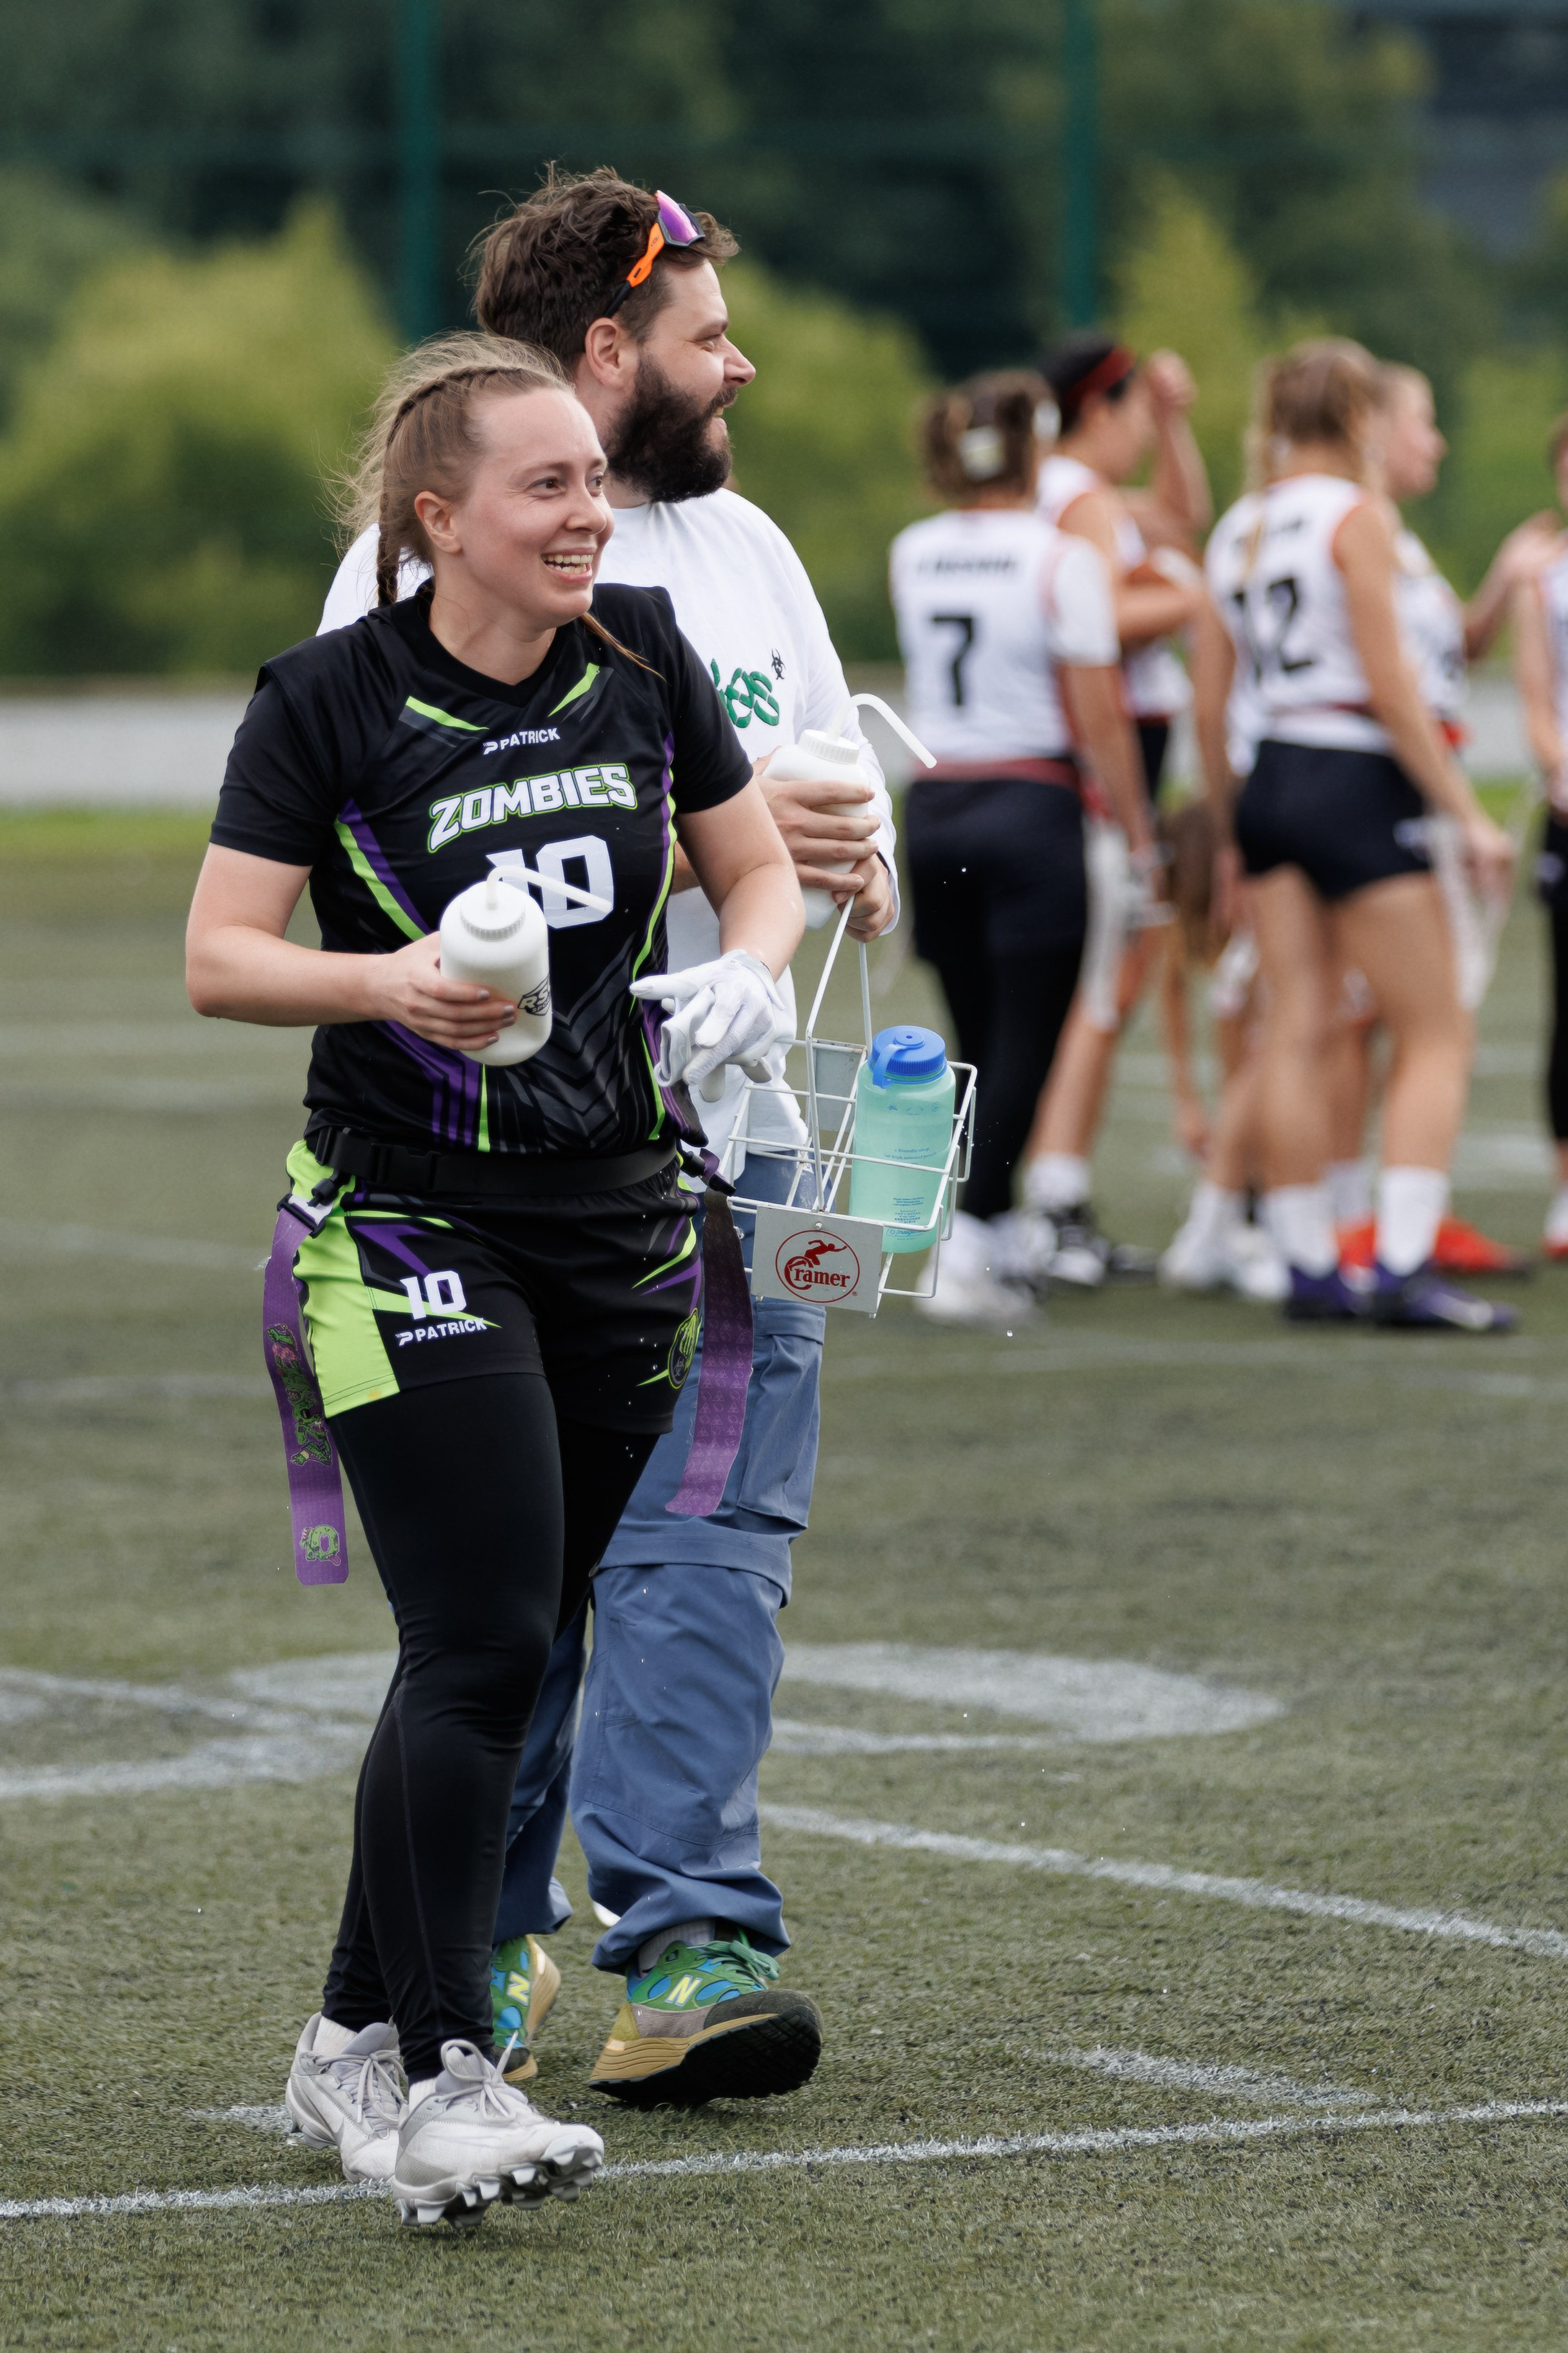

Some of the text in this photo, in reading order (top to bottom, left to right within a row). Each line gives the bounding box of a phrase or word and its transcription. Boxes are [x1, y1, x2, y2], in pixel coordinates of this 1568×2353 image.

[1232, 575, 1313, 686] 12
[931, 614, 975, 706] 7
[500, 728, 561, 750] PATRICK
[428, 763, 638, 853] ZOMBIES
[784, 1256, 851, 1290] Cramer
[399, 1270, 467, 1320] 10
[415, 1317, 487, 1342] PATRICK
[664, 1973, 704, 2007] N
